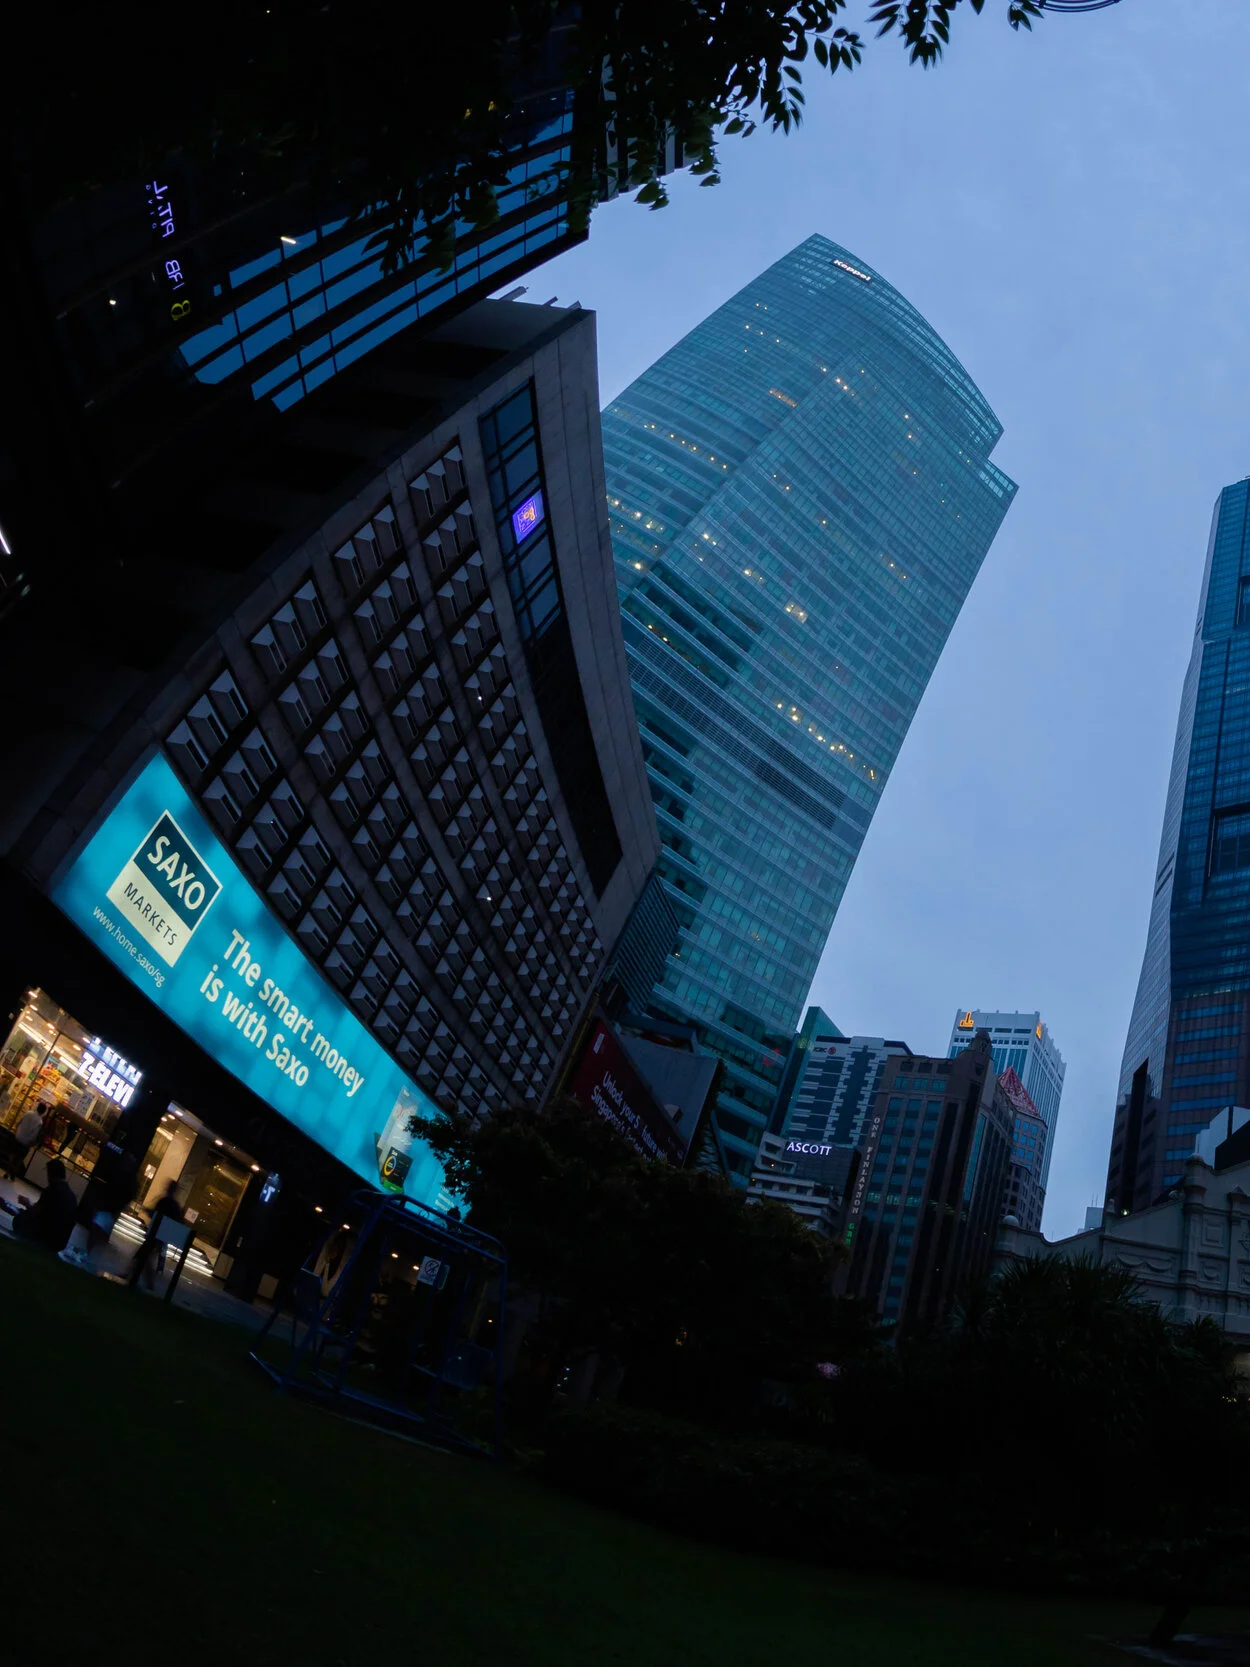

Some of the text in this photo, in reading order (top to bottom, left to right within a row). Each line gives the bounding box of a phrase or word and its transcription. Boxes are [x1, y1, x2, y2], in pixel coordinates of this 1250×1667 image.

[147, 835, 206, 910] SAXO
[92, 905, 166, 988] www.home.saxo/sg
[124, 882, 178, 946] MARKETS
[200, 964, 309, 1087] is with Saxo
[223, 928, 365, 1097] The smart money
[602, 1070, 624, 1109] Unlock
[786, 1141, 832, 1156] ASCOTT
[852, 1146, 873, 1214] FINLAYSON
